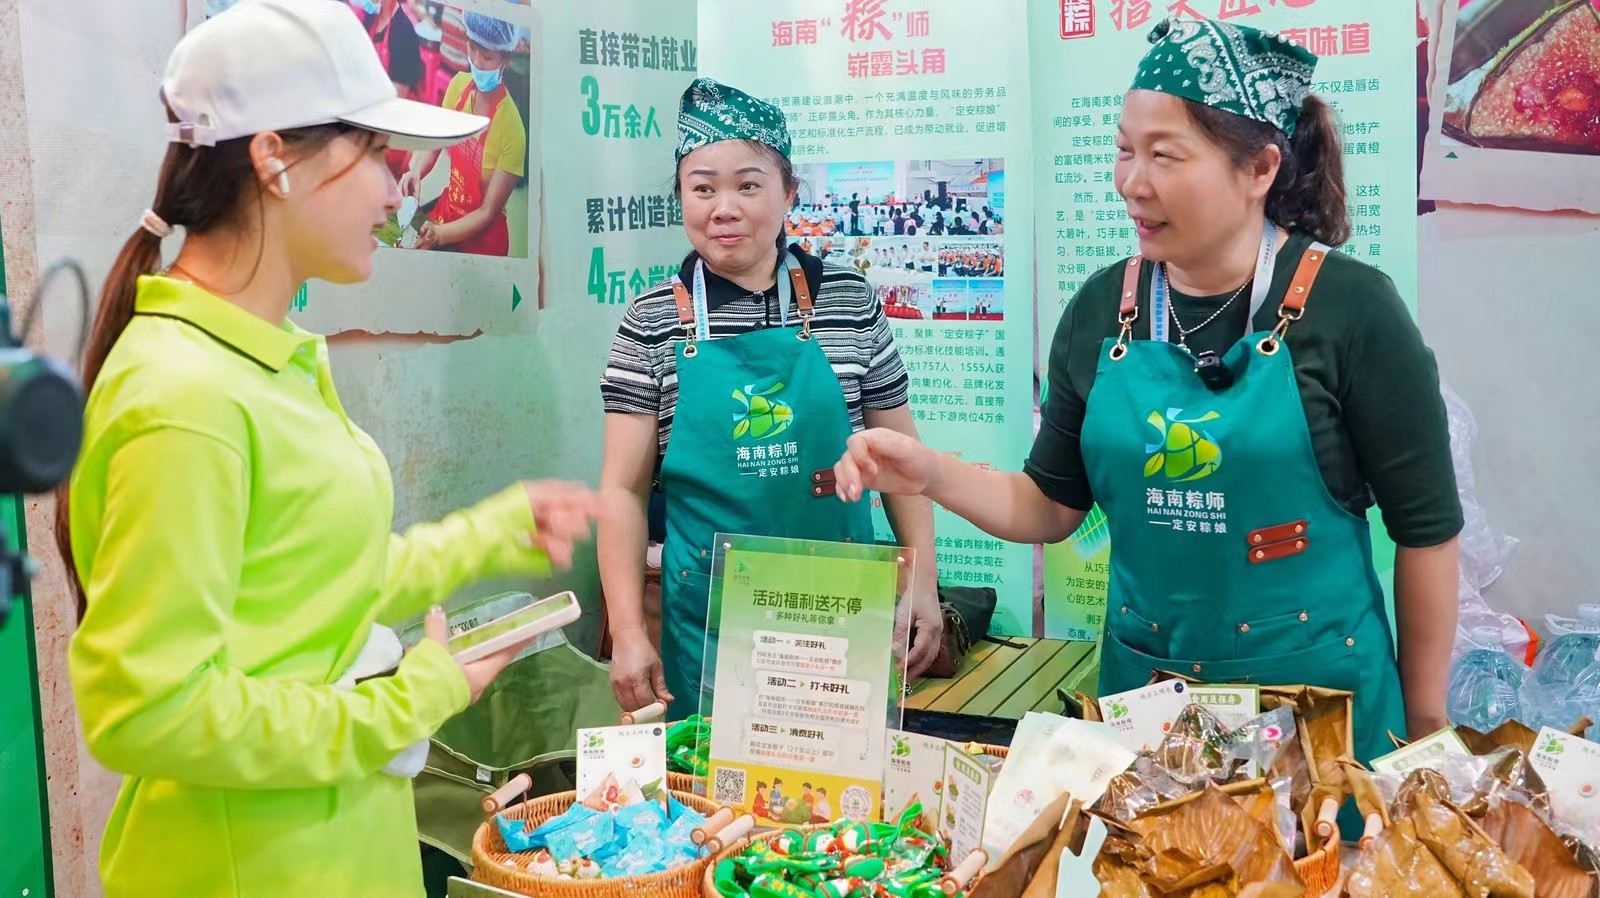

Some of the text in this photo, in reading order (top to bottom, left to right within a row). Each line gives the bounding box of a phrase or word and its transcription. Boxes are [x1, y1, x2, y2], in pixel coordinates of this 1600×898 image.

[579, 28, 697, 72] 直接带动就业
[847, 48, 946, 78] 崭露头角
[763, 86, 1006, 107] 自贸港建设浪潮中，一个充满温度与风味的劳务品
[1072, 95, 1122, 108] 在海南美食
[580, 75, 661, 139] 3万余人
[1055, 153, 1117, 166] 的富硒糯米软
[1356, 184, 1381, 197] 这技
[1056, 210, 1132, 222] 艺，是“定安粽
[1341, 243, 1381, 257] 序，层
[1057, 263, 1112, 275] 次分明，
[891, 328, 1005, 341] 县，聚焦“定安粽子”国
[908, 378, 1005, 391] 向集约化、品牌化发
[736, 441, 798, 461] 海南粽师
[767, 458, 787, 466] ZONG
[788, 456, 799, 464] SHI
[1146, 487, 1225, 511] 海南粽师
[1147, 507, 1226, 520] HAI NAN ZONG SHI
[935, 553, 1004, 567] 农村妇女实现在
[1066, 576, 1109, 590] 为定安的
[752, 588, 863, 615] 活动福利送不停
[775, 611, 835, 626] 多种好礼等你拿
[1067, 627, 1103, 640] 态度。
[760, 635, 827, 650] 活动一 关注好礼
[767, 675, 850, 694] 活动二 打卡好礼
[751, 722, 825, 740] 活动三 消费好礼
